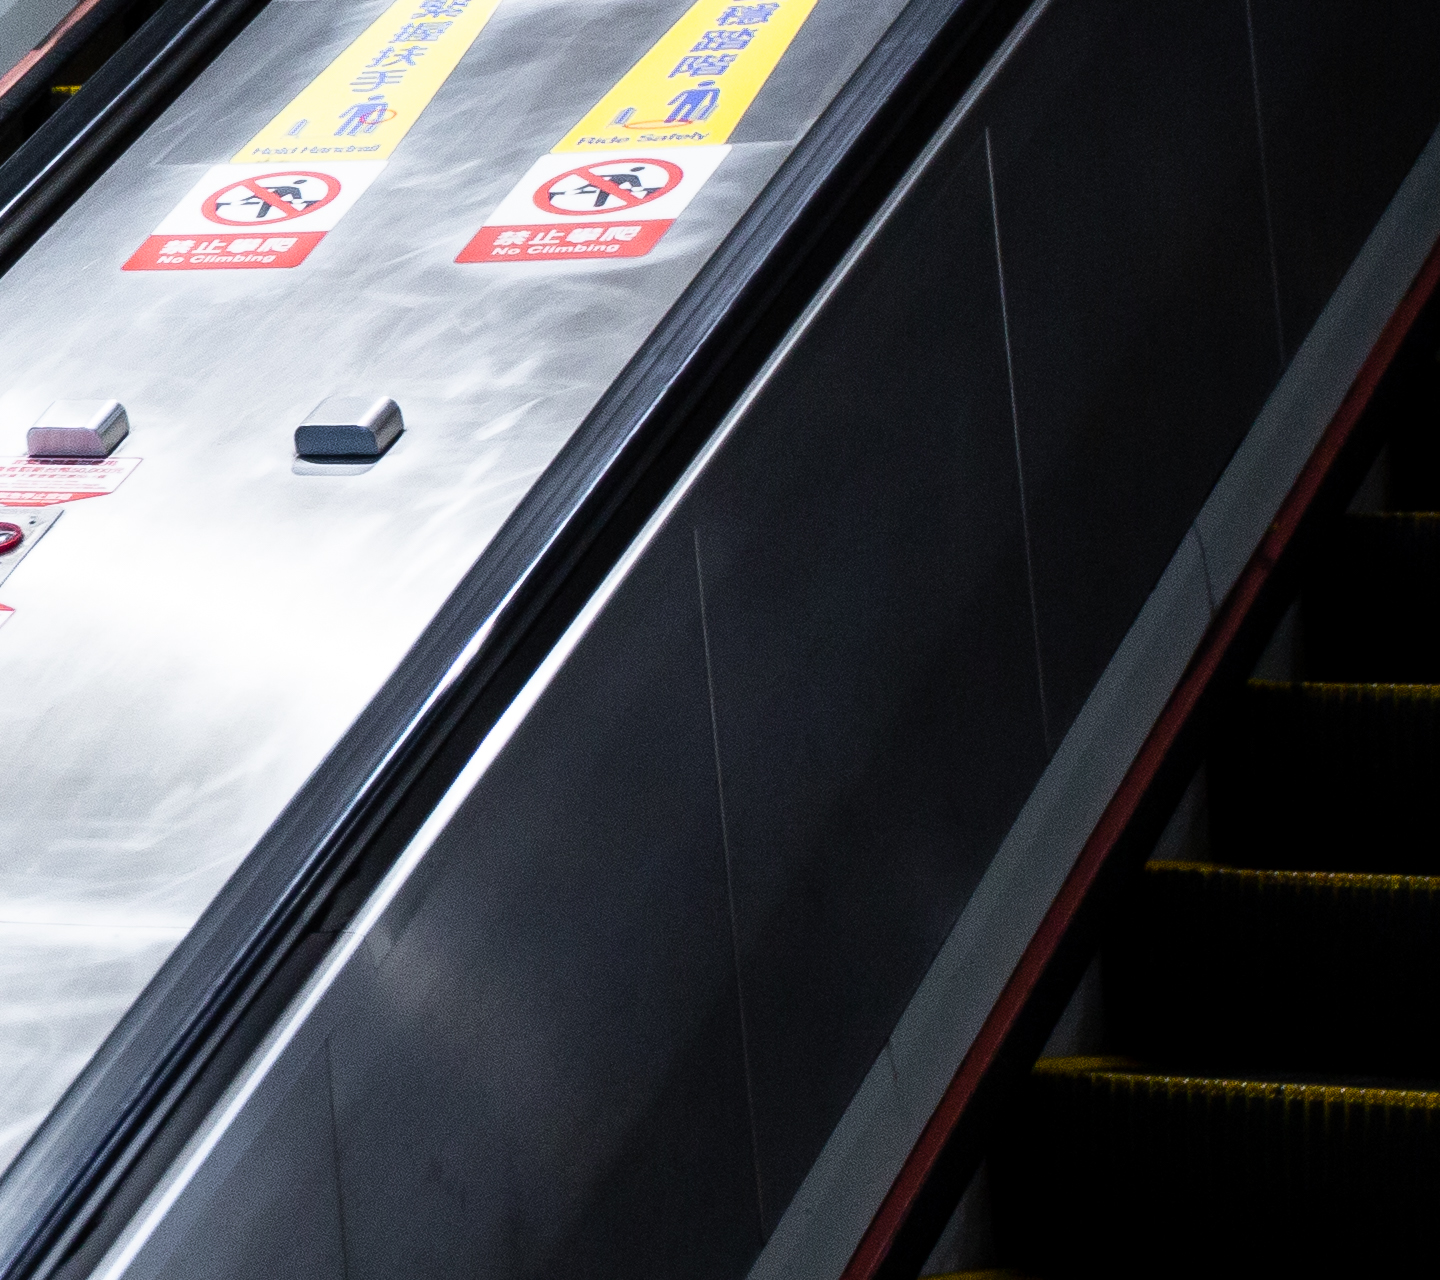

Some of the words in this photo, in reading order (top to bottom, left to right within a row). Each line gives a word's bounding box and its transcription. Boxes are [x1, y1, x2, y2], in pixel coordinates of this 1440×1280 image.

[576, 135, 630, 146] Ride
[637, 132, 710, 143] Safely
[490, 246, 521, 256] No
[527, 244, 621, 255] Climbing
[156, 255, 185, 264] No
[189, 254, 277, 264] Climbing
